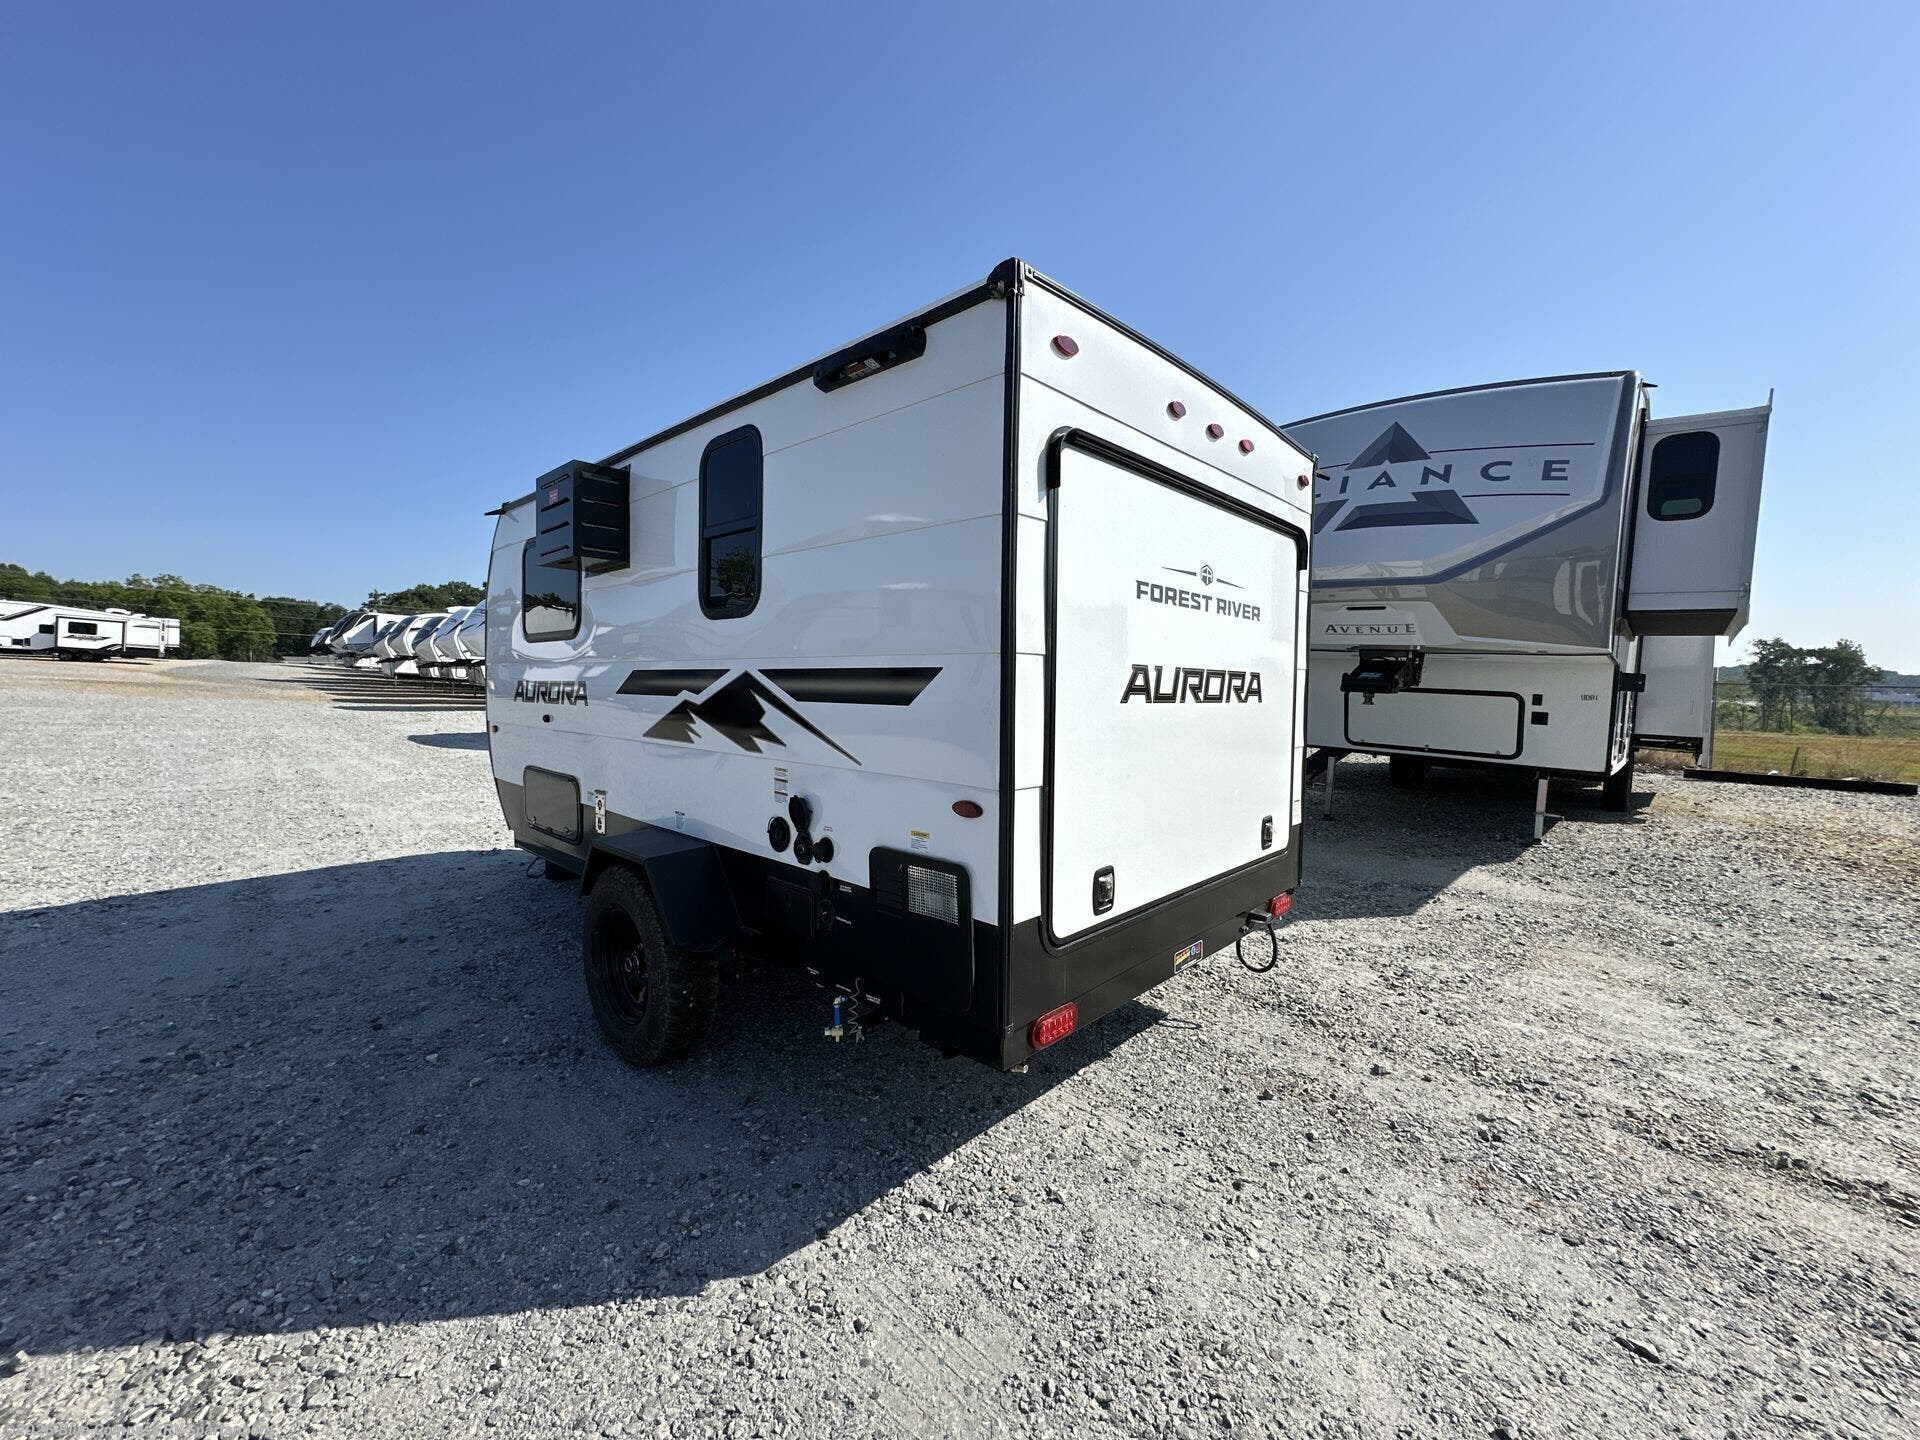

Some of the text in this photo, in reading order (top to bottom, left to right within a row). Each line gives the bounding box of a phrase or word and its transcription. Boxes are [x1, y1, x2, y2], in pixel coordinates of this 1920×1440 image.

[1315, 459, 1570, 498] IANCE
[1136, 580, 1261, 622] FOREST RIVER
[1325, 623, 1416, 633] AVENUE
[513, 680, 589, 706] AURORA
[1120, 663, 1263, 704] AURORA
